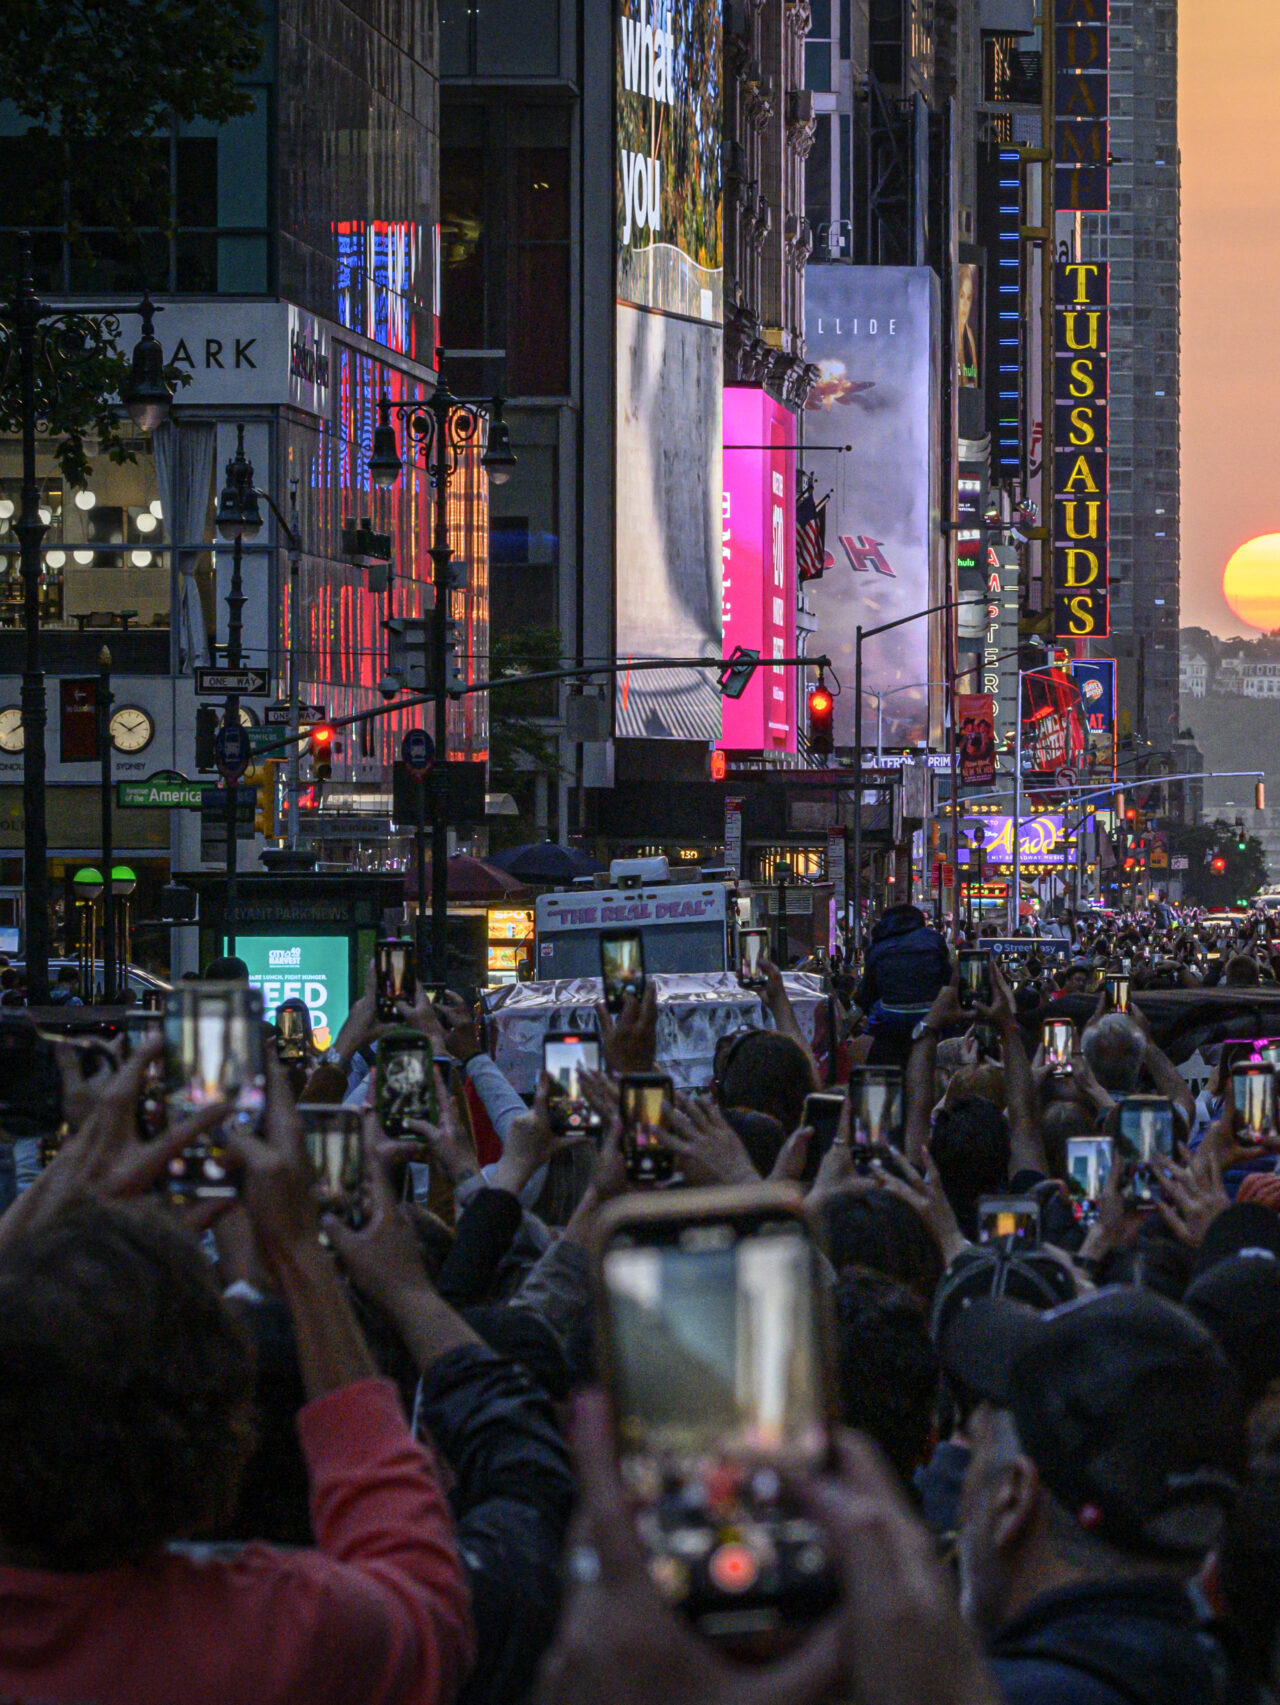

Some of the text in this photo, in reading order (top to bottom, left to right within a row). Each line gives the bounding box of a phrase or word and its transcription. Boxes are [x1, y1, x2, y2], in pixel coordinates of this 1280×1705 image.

[621, 0, 674, 105] what
[621, 149, 660, 245] you
[1063, 264, 1101, 634] TUSSAUD'S
[957, 557, 975, 567] hulu
[209, 677, 257, 686] ONE WAY
[1086, 713, 1106, 729] AT.
[116, 762, 146, 771] SYDNEY
[928, 757, 951, 767] PRIM
[601, 903, 652, 923] REAL
[1004, 943, 1056, 953] Streetasy
